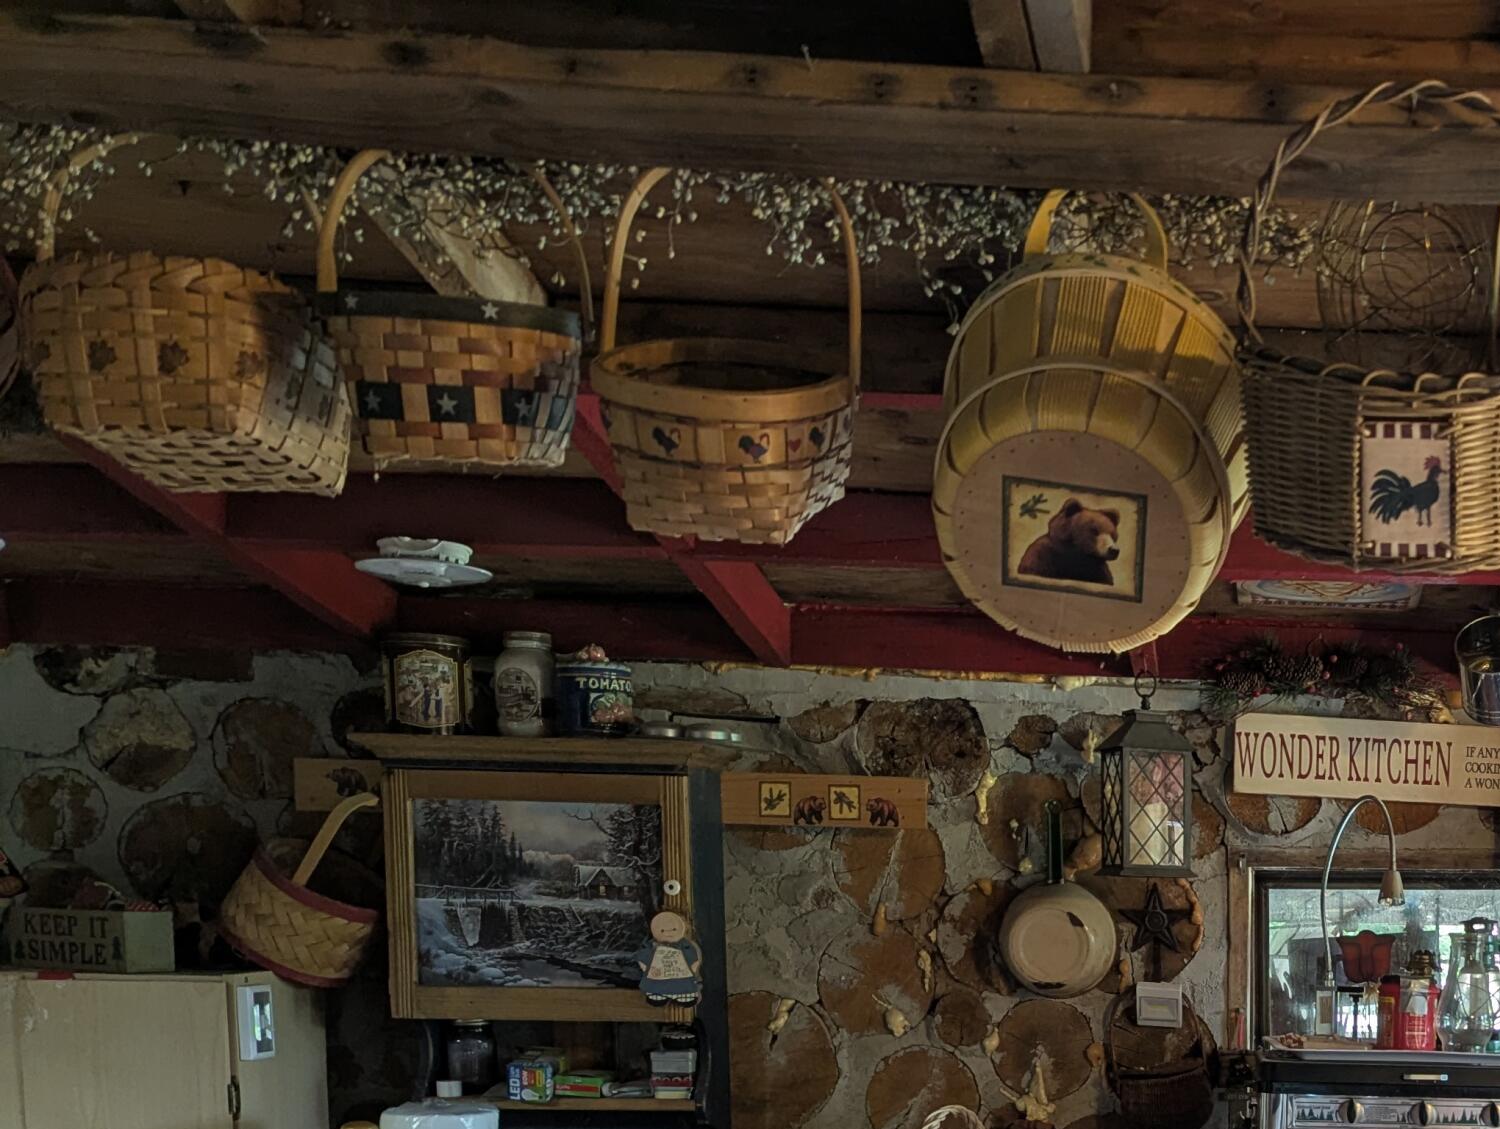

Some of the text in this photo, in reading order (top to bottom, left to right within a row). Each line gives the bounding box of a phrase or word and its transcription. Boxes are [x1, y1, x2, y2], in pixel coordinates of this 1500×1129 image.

[1236, 731, 1453, 788] WONDER KITCHEN
[1465, 746, 1477, 758] IF
[1463, 777, 1473, 789] A
[23, 913, 110, 940] KEEP IT
[27, 938, 108, 965] SIMPLE
[510, 1078, 521, 1100] LED
